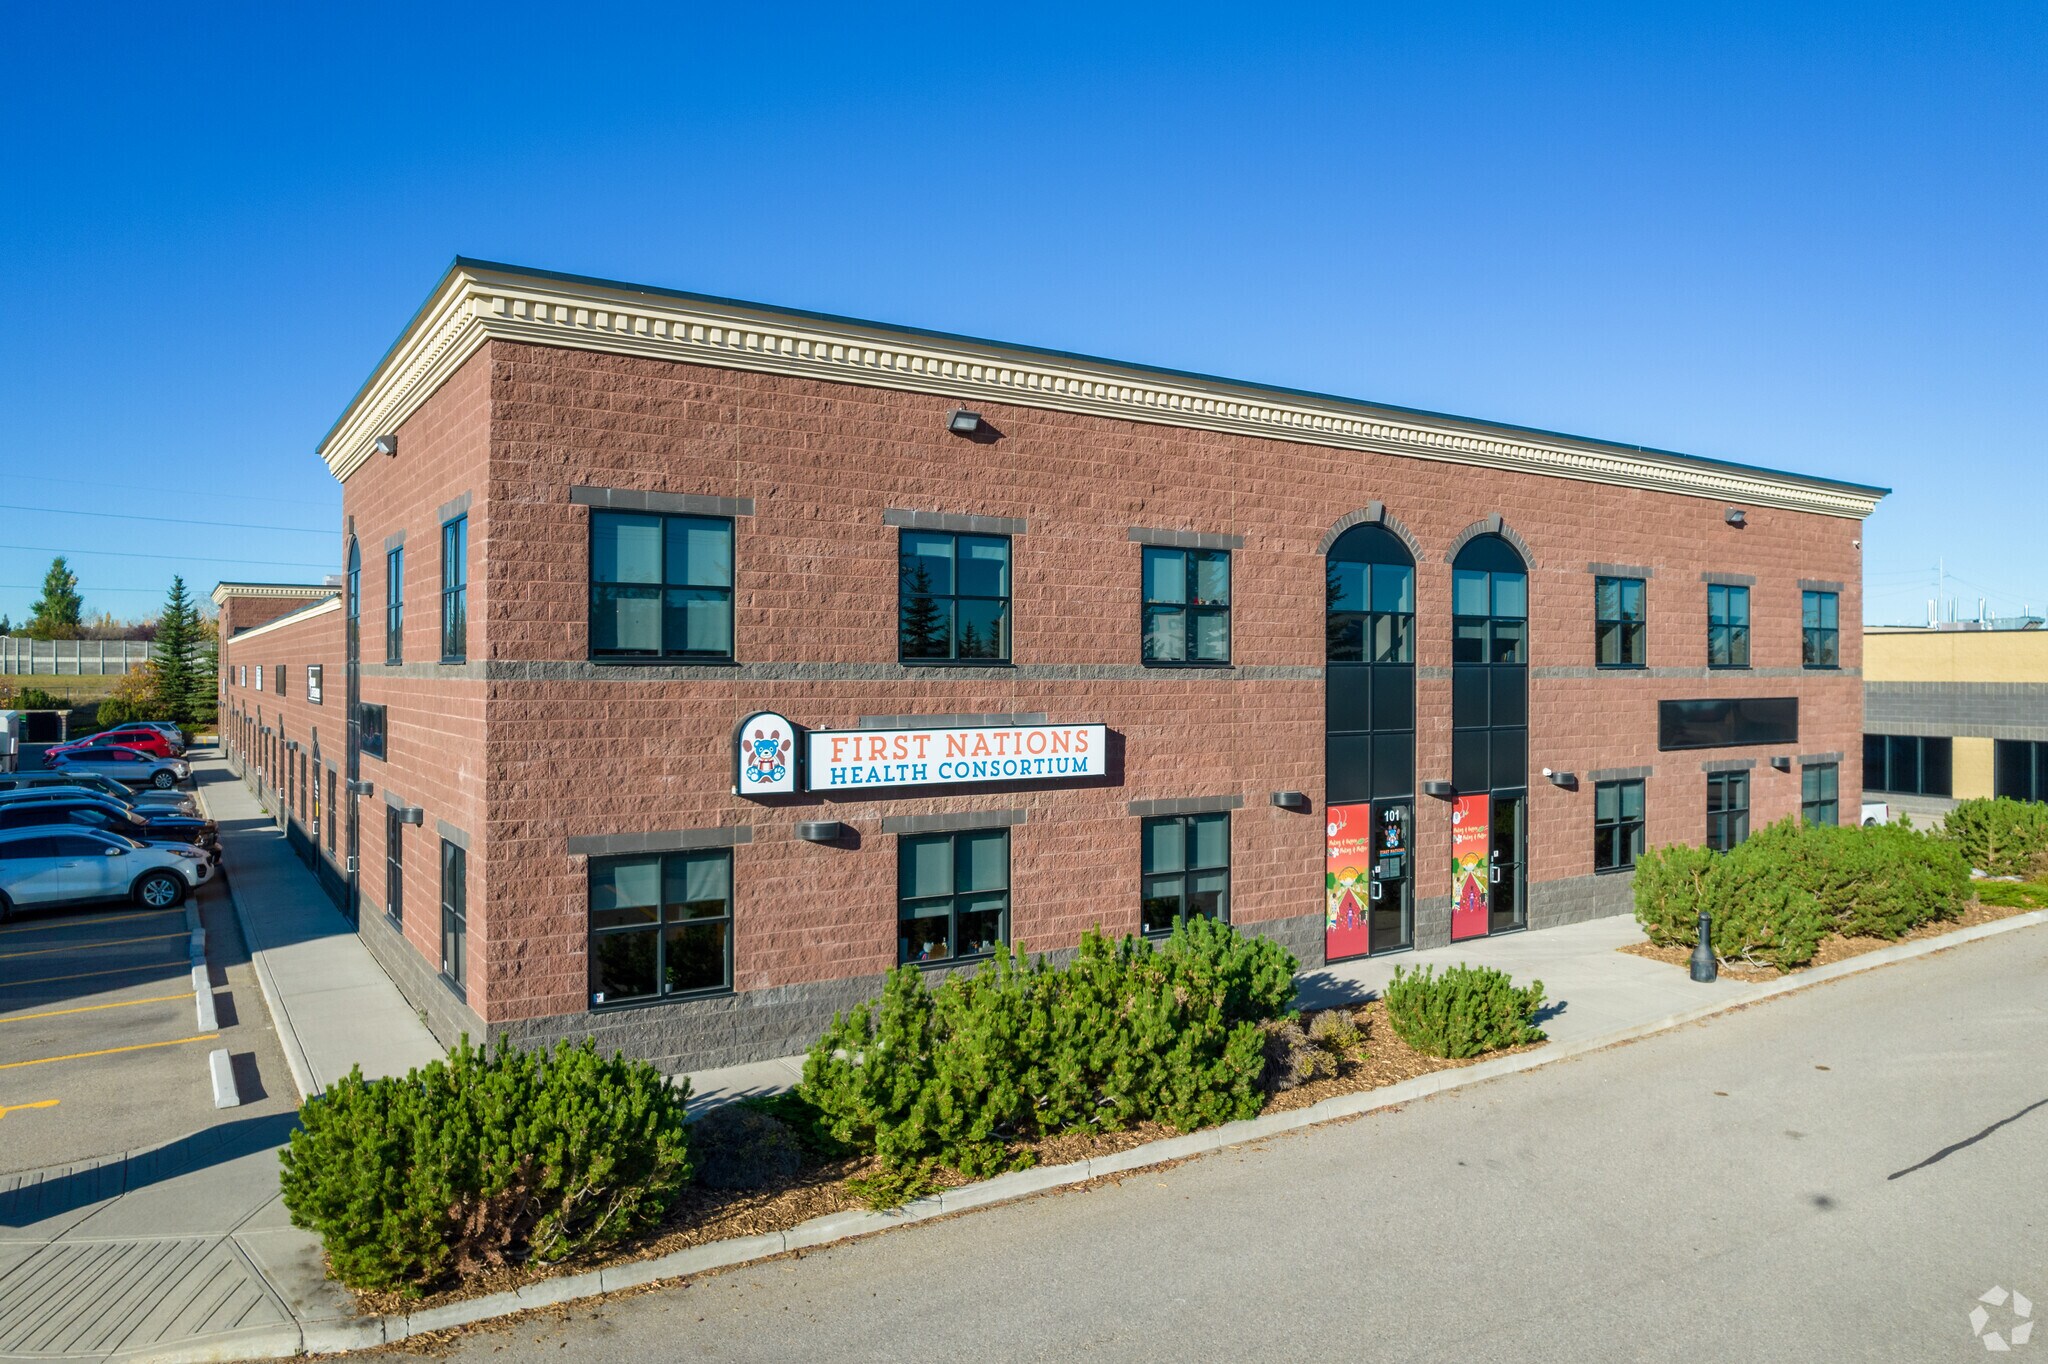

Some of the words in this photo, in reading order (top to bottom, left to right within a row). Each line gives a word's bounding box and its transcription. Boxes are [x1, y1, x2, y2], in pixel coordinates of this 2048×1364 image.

[831, 735, 931, 763] FIRST
[946, 730, 1089, 758] NATIONS
[830, 763, 928, 785] HEALTH
[938, 757, 1088, 779] CONSORTIUM
[1384, 810, 1400, 822] 101
